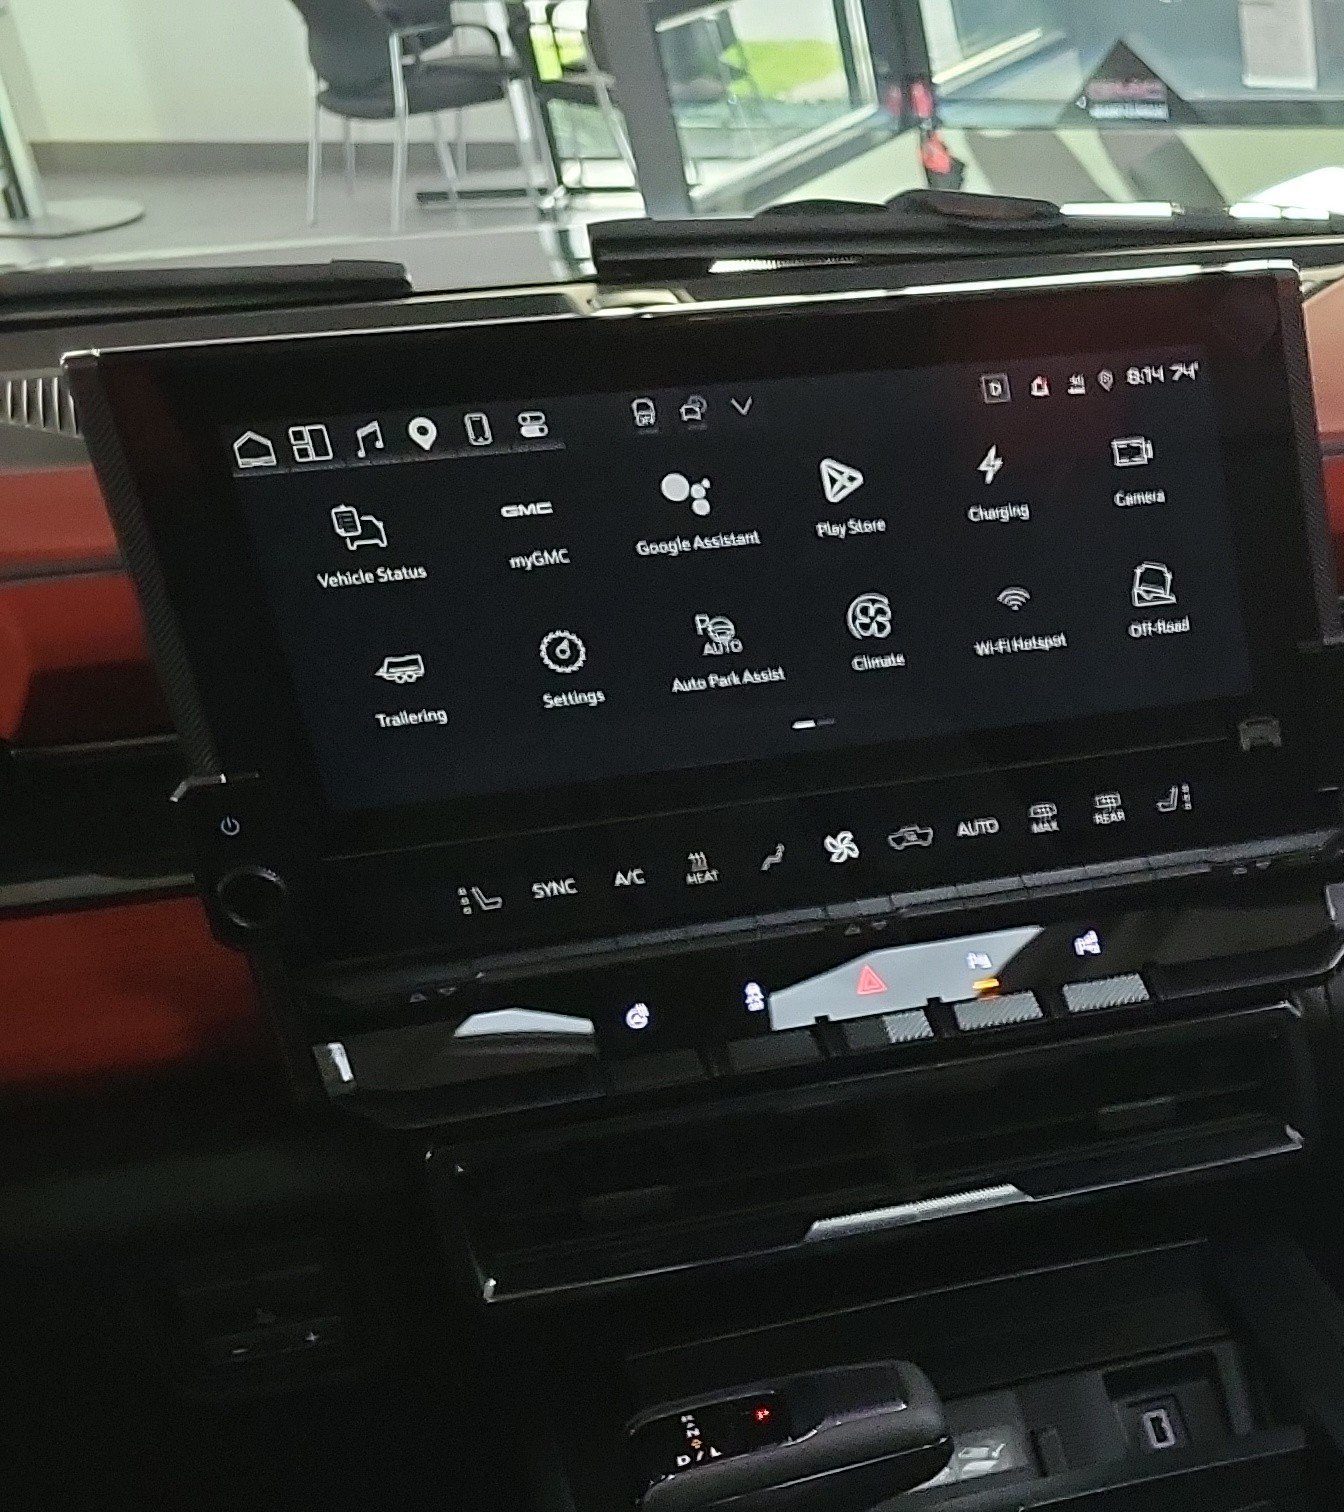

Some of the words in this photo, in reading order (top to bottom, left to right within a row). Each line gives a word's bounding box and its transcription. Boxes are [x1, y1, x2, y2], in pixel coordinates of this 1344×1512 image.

[500, 501, 553, 518] GMC
[1114, 490, 1166, 508] Camera
[967, 503, 1030, 524] Charging
[815, 520, 847, 540] Play
[848, 517, 887, 535] Store
[636, 537, 692, 558] Google
[693, 529, 761, 552] Assistant
[509, 548, 571, 570] myGMC
[317, 569, 375, 590] Vehicle
[376, 564, 427, 583] Status
[1128, 616, 1190, 639] Off-Road
[702, 637, 743, 656] AUTO
[973, 638, 1011, 657] Wi-Fi
[1012, 632, 1068, 654] Hotspot
[851, 651, 906, 671] Climate
[671, 676, 707, 694] Auto
[708, 671, 742, 690] Park
[741, 666, 786, 685] Assist
[542, 689, 606, 709] Settings
[375, 707, 449, 729] Trailering
[957, 817, 1000, 837] AUTO
[1093, 810, 1126, 824] REAR
[614, 868, 647, 887] A/C
[686, 869, 720, 885] HEAT
[531, 877, 578, 899] SYNC
